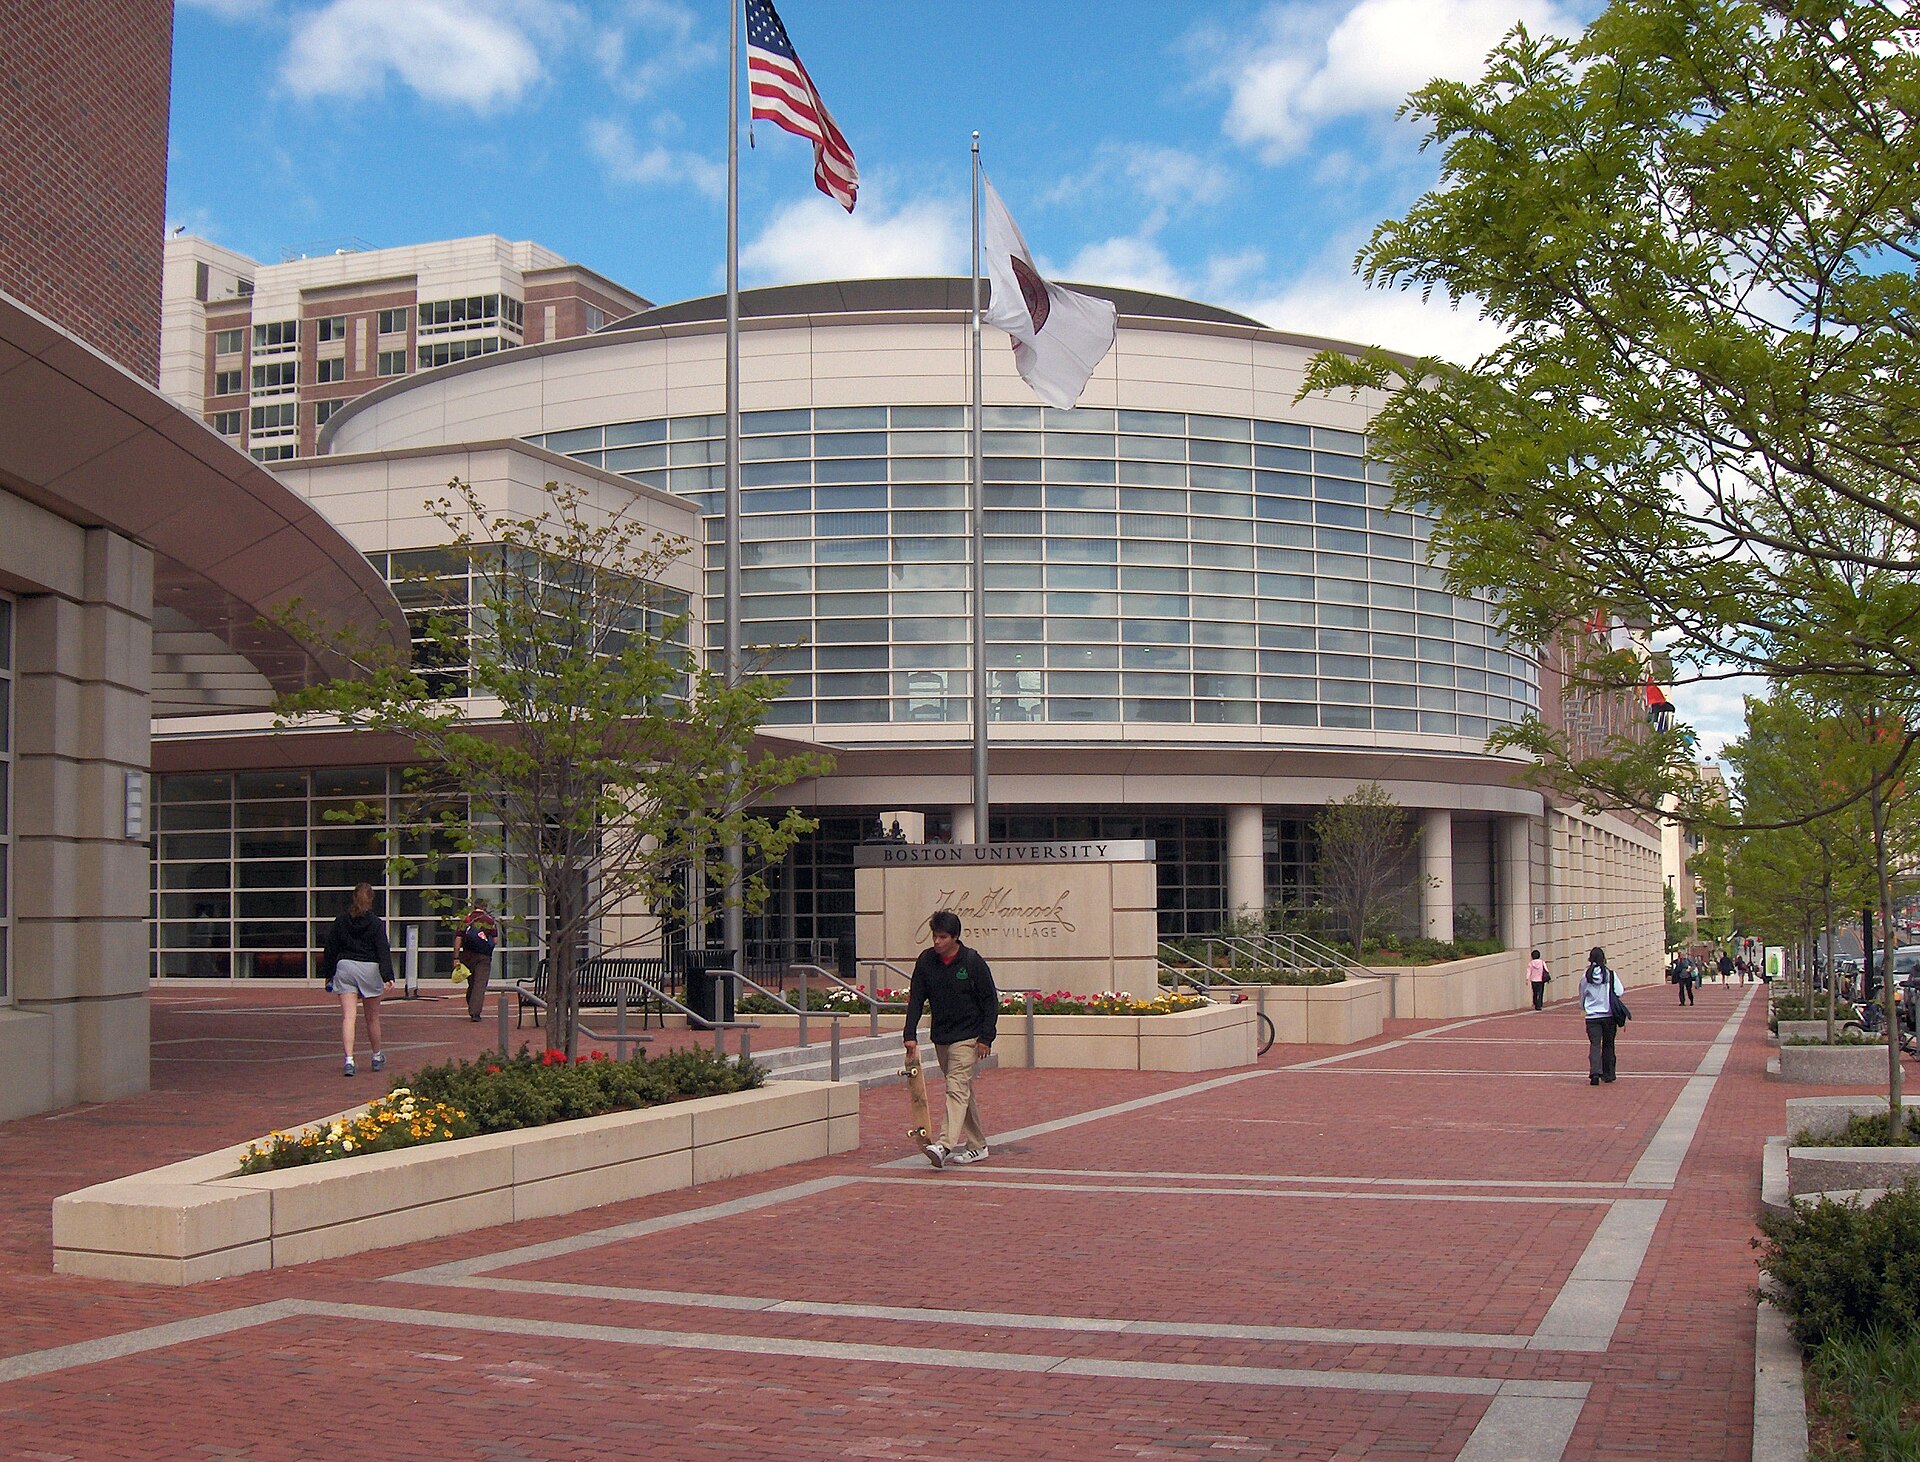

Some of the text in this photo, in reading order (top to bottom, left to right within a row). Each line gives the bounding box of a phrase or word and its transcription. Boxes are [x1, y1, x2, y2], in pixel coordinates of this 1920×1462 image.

[883, 844, 1107, 861] BOSTON UNIVERSITY
[914, 887, 1076, 944] John Hancock
[963, 927, 1057, 938] DENT VILLAGE
